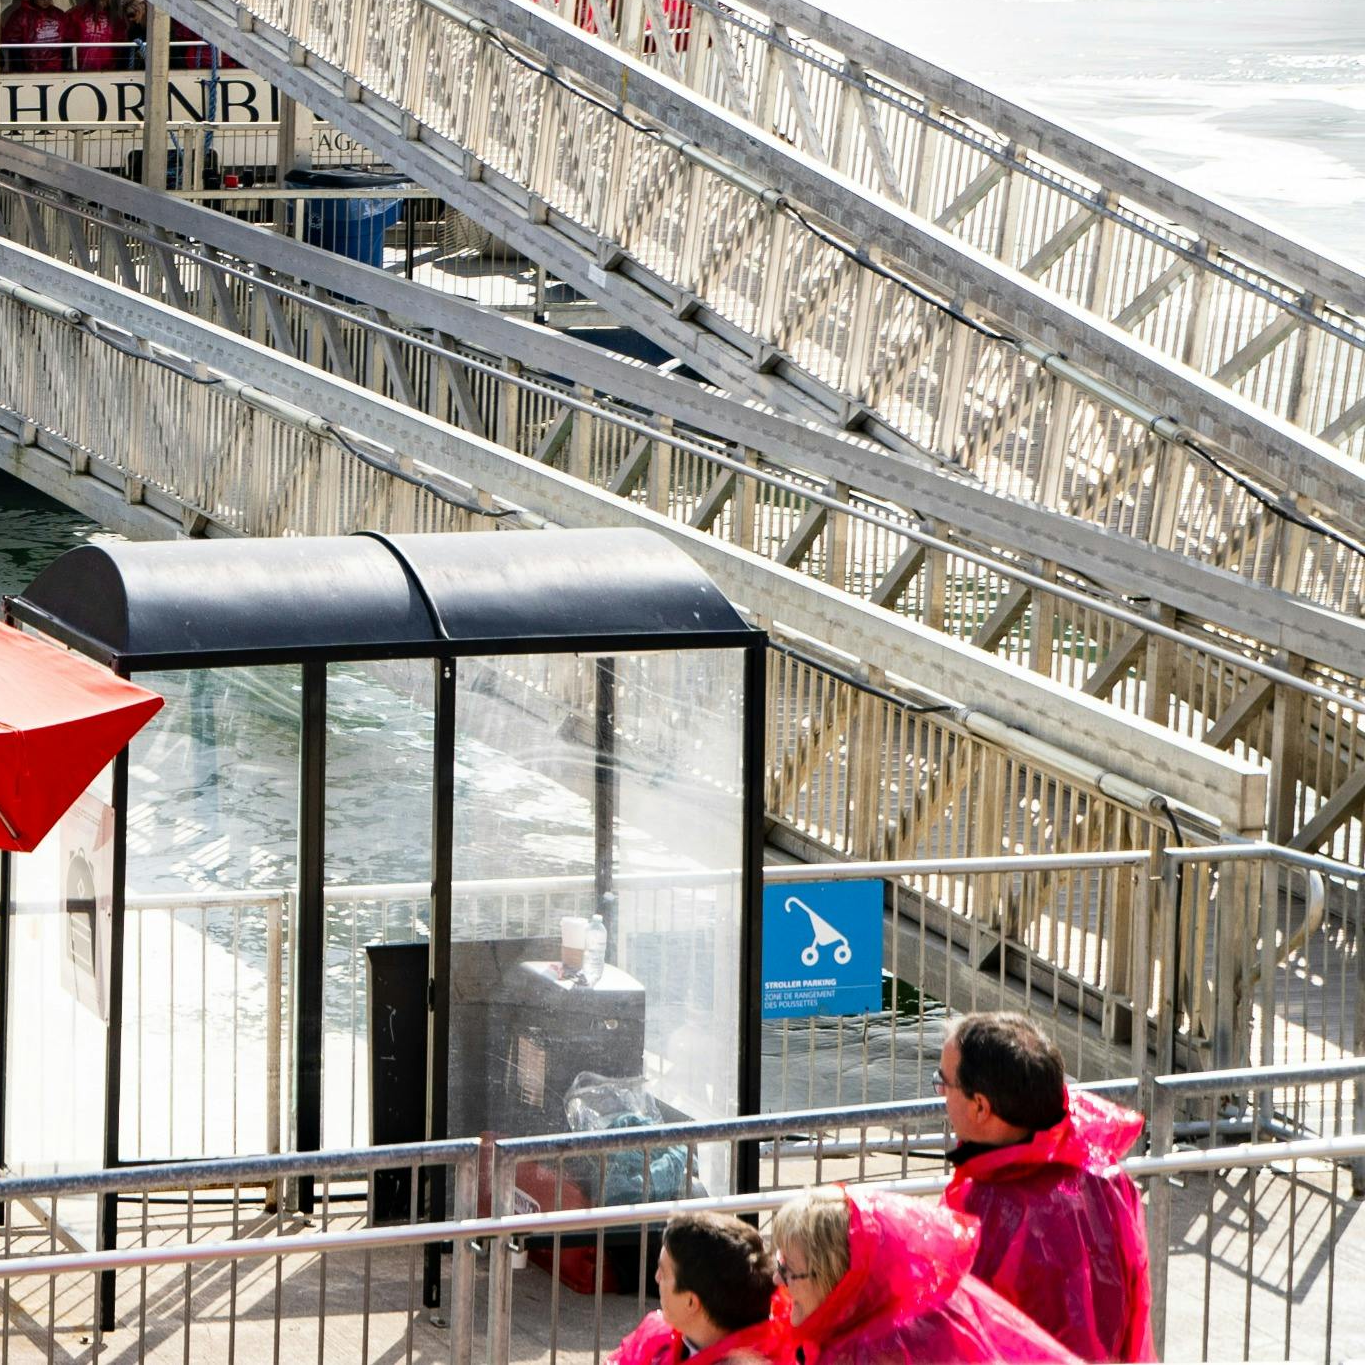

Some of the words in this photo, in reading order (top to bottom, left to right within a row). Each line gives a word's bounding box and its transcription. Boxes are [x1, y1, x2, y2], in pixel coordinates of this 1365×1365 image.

[764, 980, 801, 989] STROLLER
[803, 978, 837, 987] PARKING
[764, 992, 782, 1001] ZONE
[784, 992, 793, 1000] DE
[794, 990, 835, 999] RANGEMENT
[764, 1001, 777, 1009] DES
[779, 999, 818, 1008] POUSSETTES
